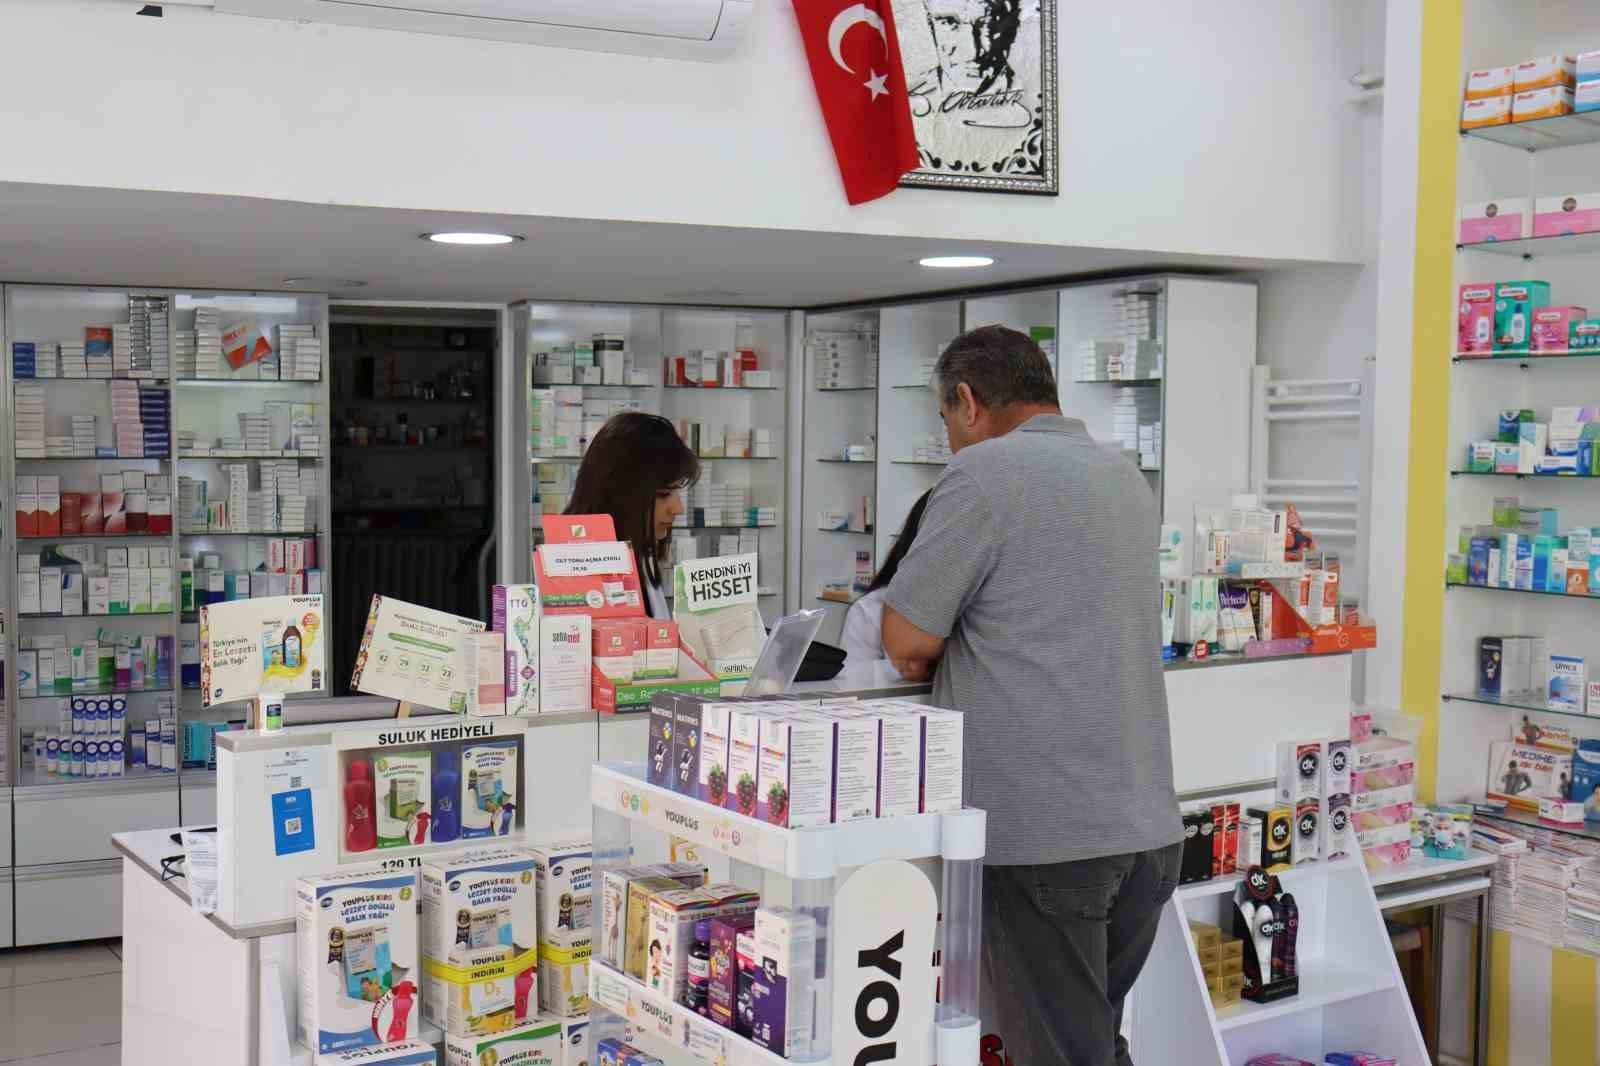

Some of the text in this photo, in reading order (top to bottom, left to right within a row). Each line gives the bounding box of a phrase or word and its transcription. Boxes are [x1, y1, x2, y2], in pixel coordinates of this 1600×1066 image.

[378, 721, 494, 745] SULUK HEDİYELİ
[665, 808, 699, 831] YOUPLUS
[469, 879, 498, 890] YOUPLUS
[468, 888, 491, 899] LEZZET
[342, 894, 375, 908] YOUPLUS
[472, 897, 492, 906] BALIK
[340, 904, 368, 916] LEZZET
[345, 914, 367, 924] BALIK
[471, 955, 505, 966] YOUPLUS
[641, 1000, 673, 1025] YOUPLUS
